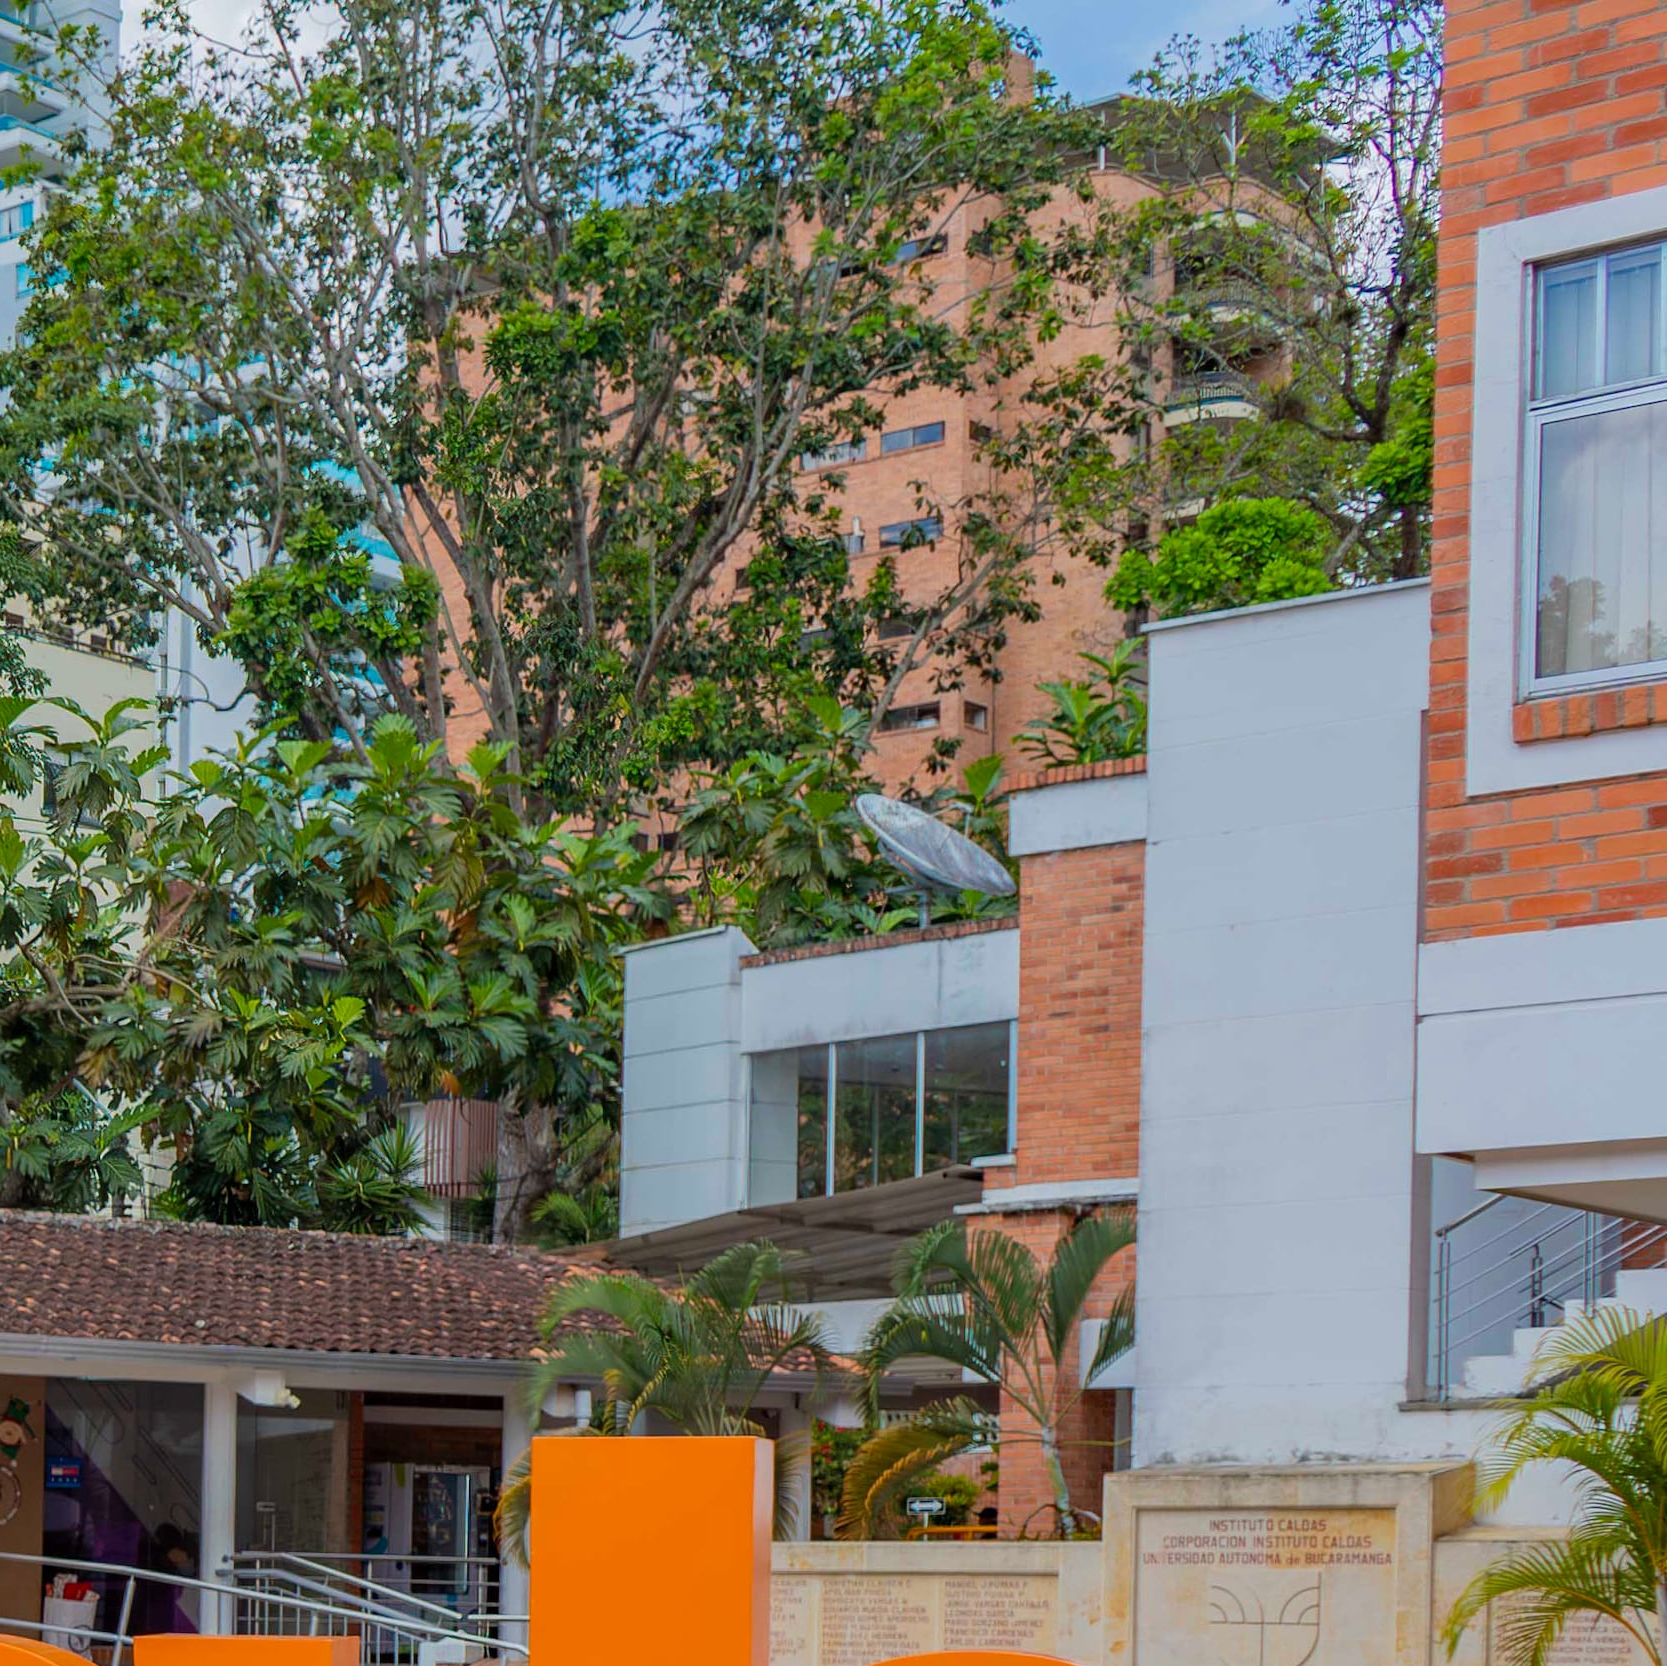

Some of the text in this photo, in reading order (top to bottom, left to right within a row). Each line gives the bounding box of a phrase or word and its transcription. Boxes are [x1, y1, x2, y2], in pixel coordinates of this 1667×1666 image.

[1210, 1519, 1326, 1532] INSTITUTO CALDAS
[1163, 1535, 1372, 1549] CORPORACION INSTITUTO CALDAS
[1219, 1551, 1280, 1564] AUTONOMA
[1305, 1552, 1392, 1565] BUCARAMANGA
